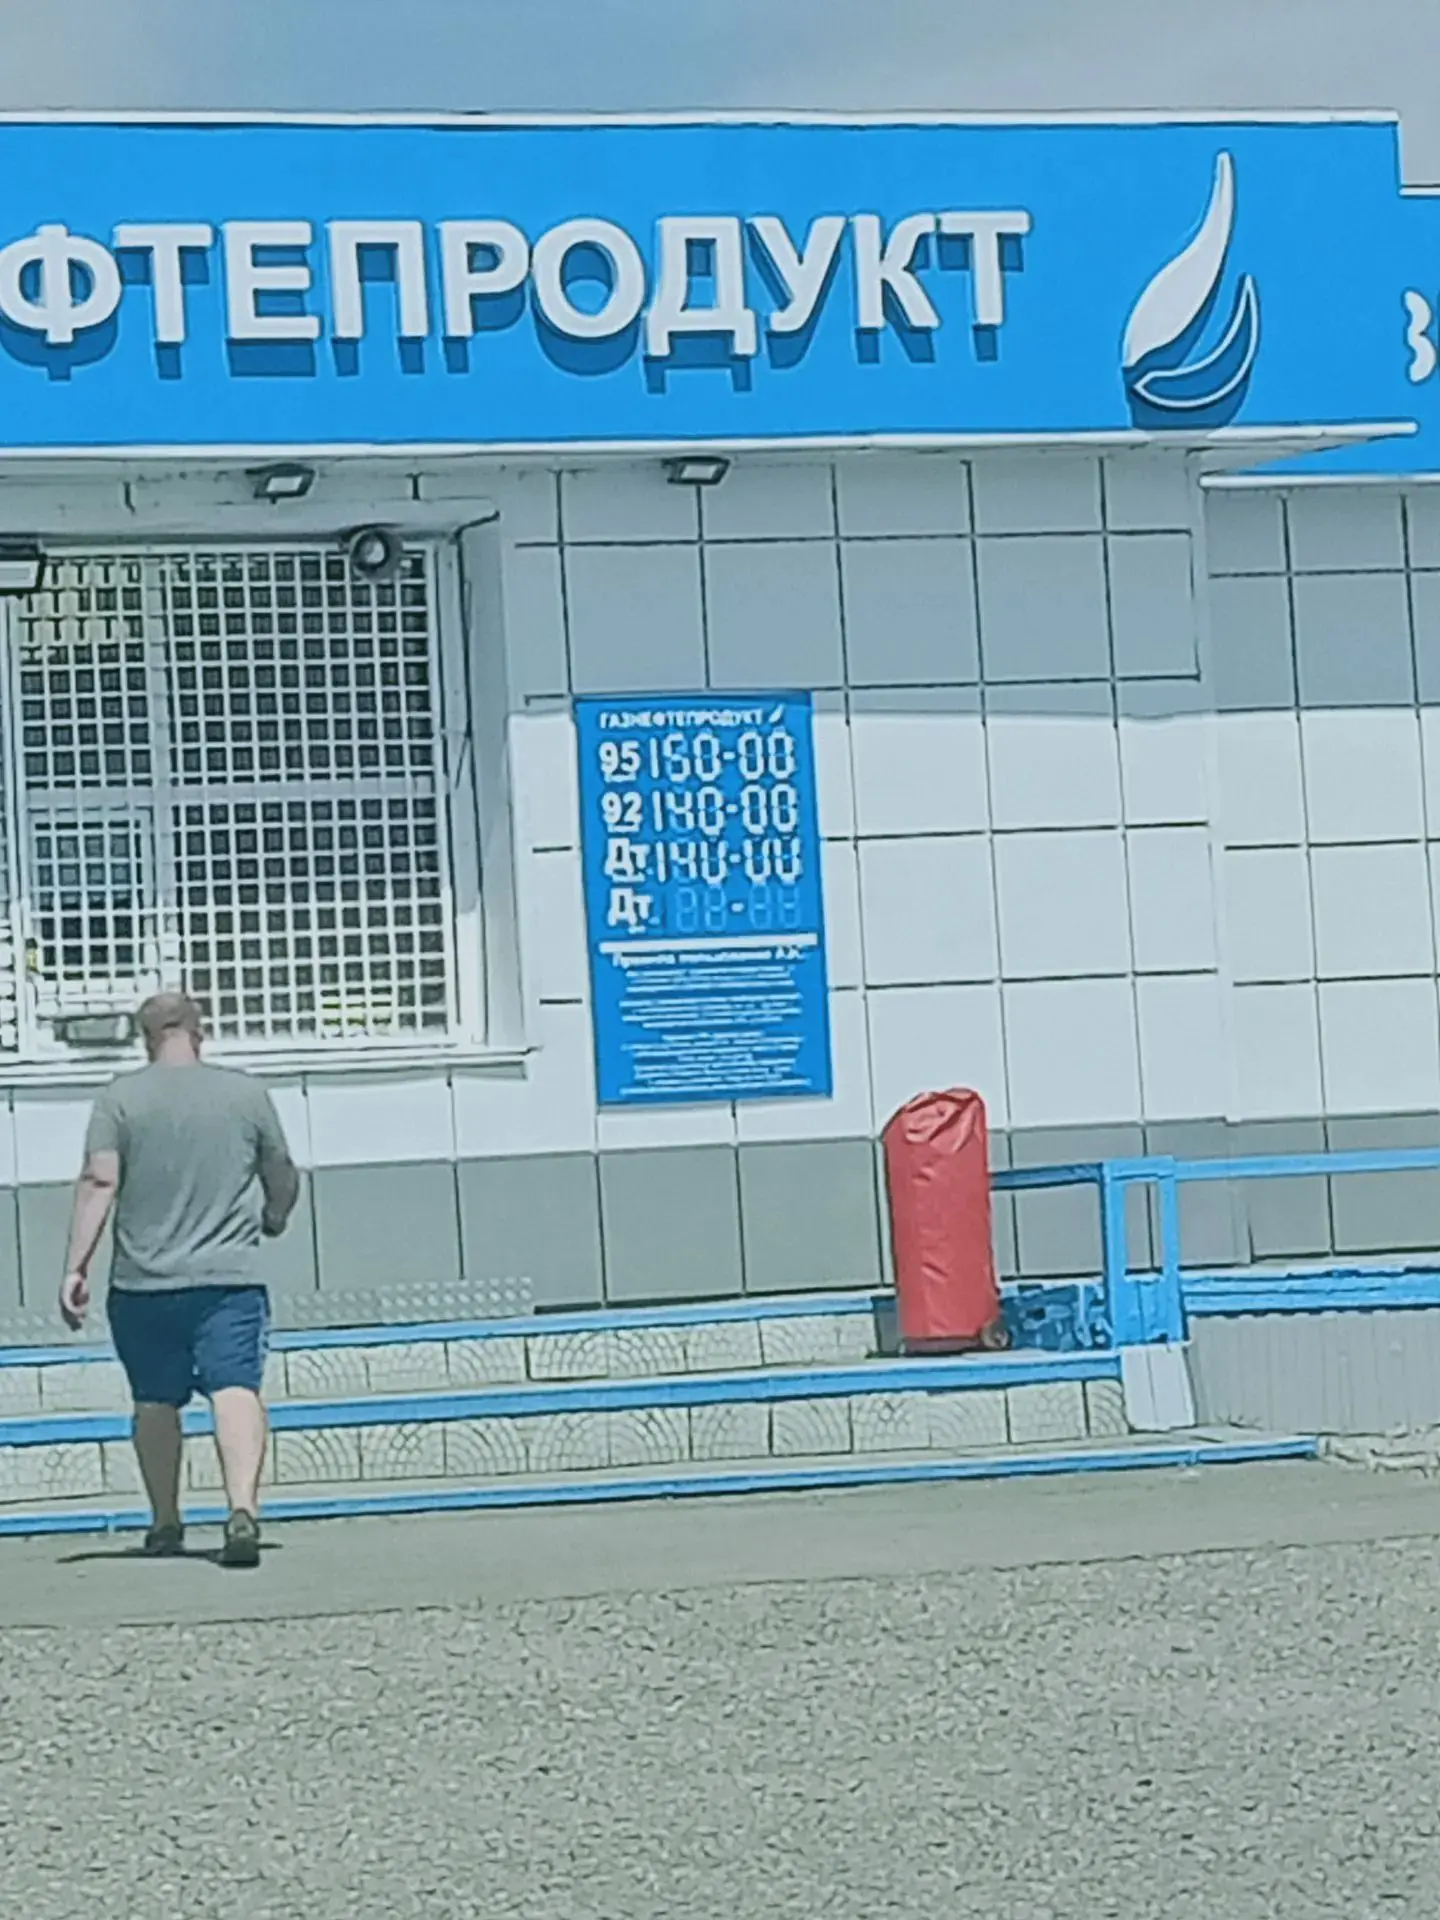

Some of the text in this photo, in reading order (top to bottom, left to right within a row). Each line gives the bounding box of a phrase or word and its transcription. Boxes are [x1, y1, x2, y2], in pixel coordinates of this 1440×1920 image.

[0, 210, 1030, 357] ФТЕПРОДУКТ
[600, 741, 641, 774] 95
[602, 785, 798, 836] 92 140-00
